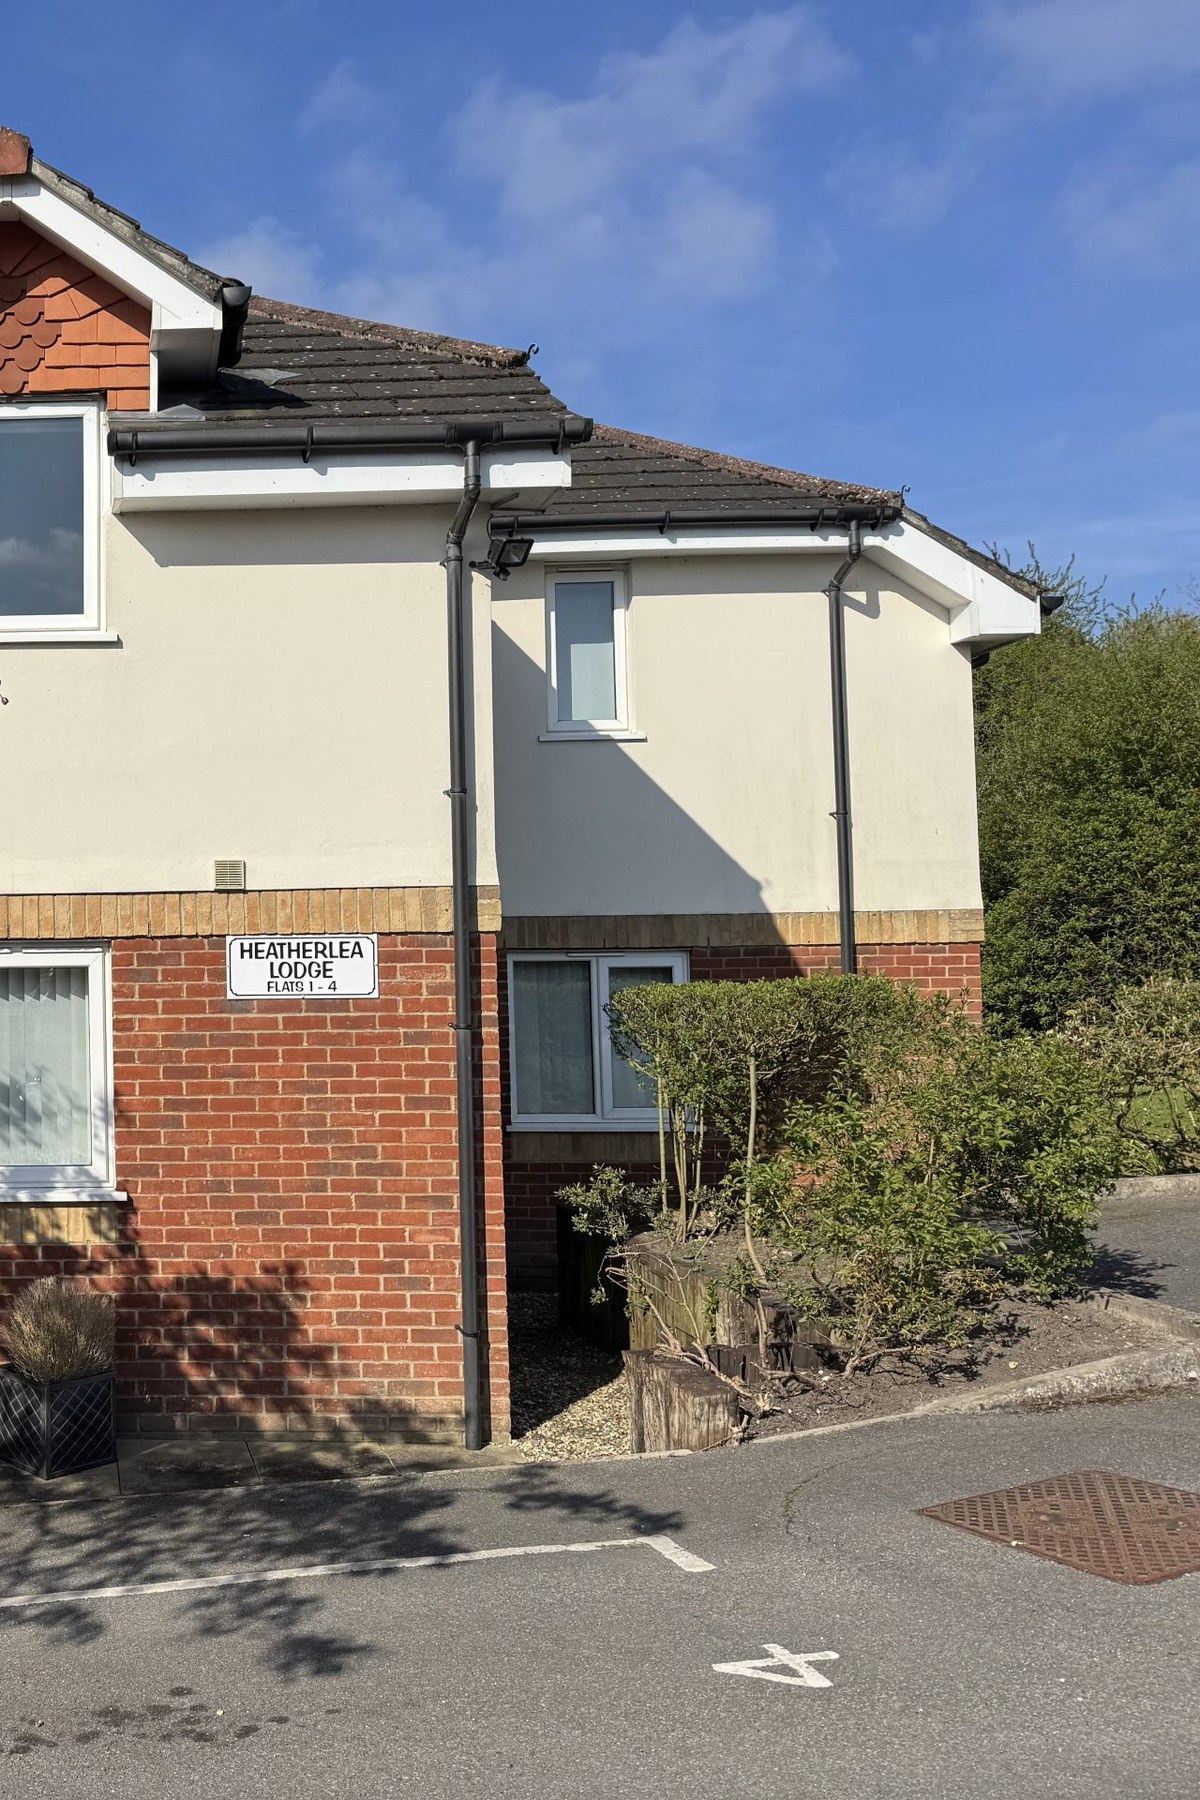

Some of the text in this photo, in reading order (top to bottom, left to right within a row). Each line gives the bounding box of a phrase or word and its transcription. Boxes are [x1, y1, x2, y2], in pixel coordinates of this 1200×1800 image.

[239, 941, 363, 959] HEATHERLEA
[269, 961, 334, 979] LODGE
[267, 981, 304, 992] FLATS
[309, 981, 313, 992] 1
[328, 980, 337, 992] 4
[711, 1643, 840, 1688] 4
